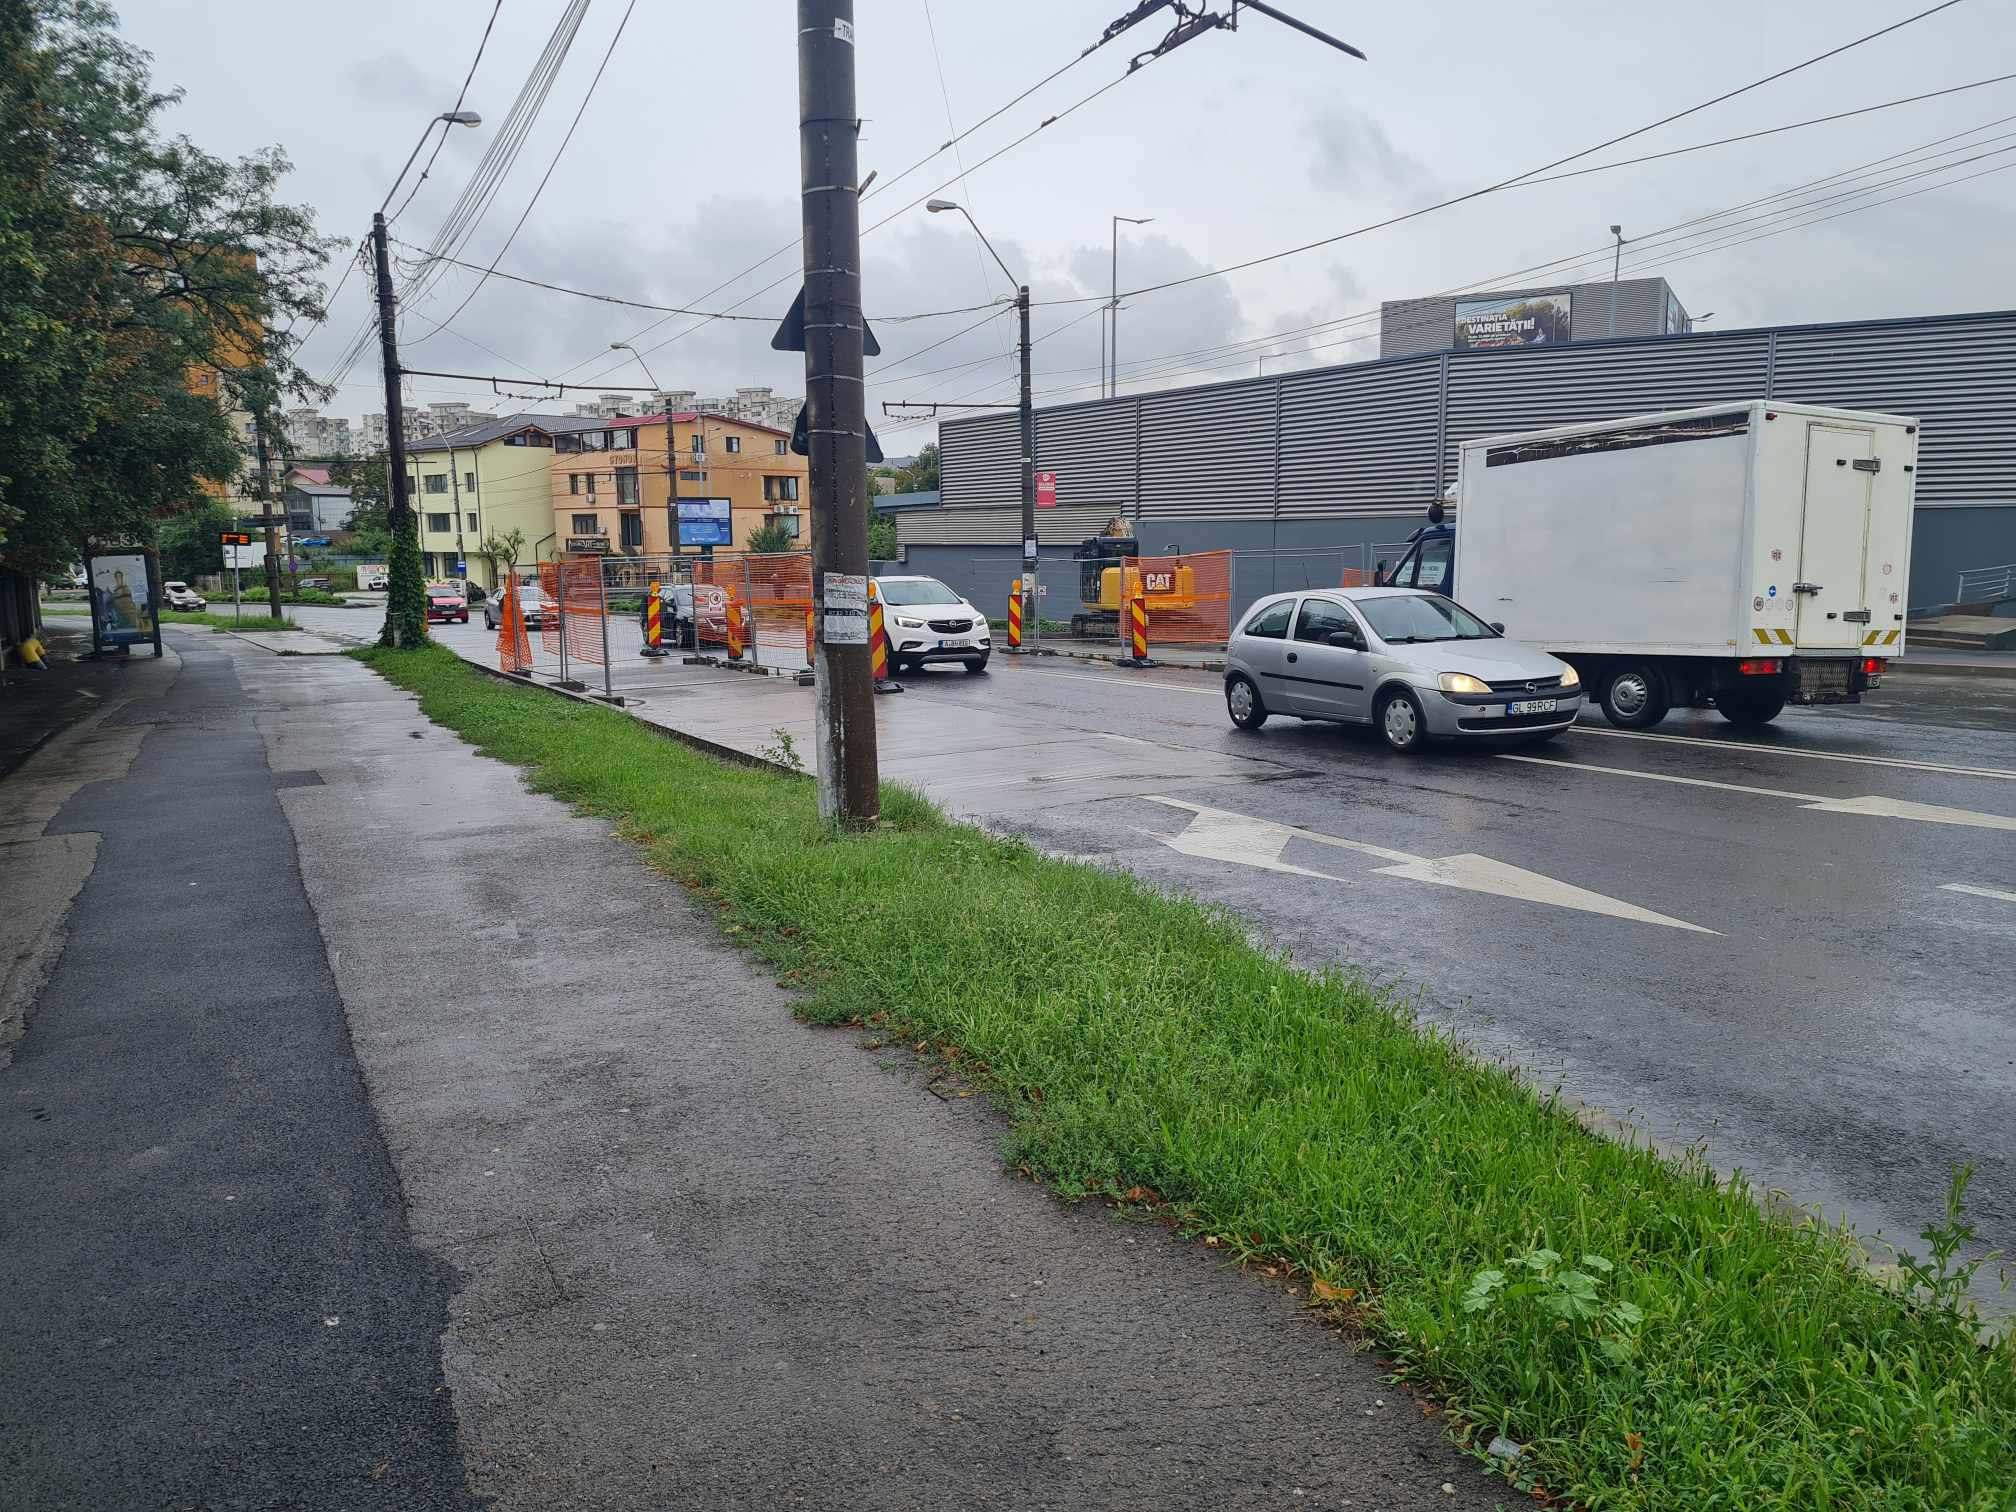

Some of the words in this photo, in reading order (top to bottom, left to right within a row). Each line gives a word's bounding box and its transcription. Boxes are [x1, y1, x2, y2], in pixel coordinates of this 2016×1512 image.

[1469, 317, 1535, 335] VARIETĂȚII!
[1147, 573, 1171, 591] CAT
[1512, 703, 1524, 713] GL
